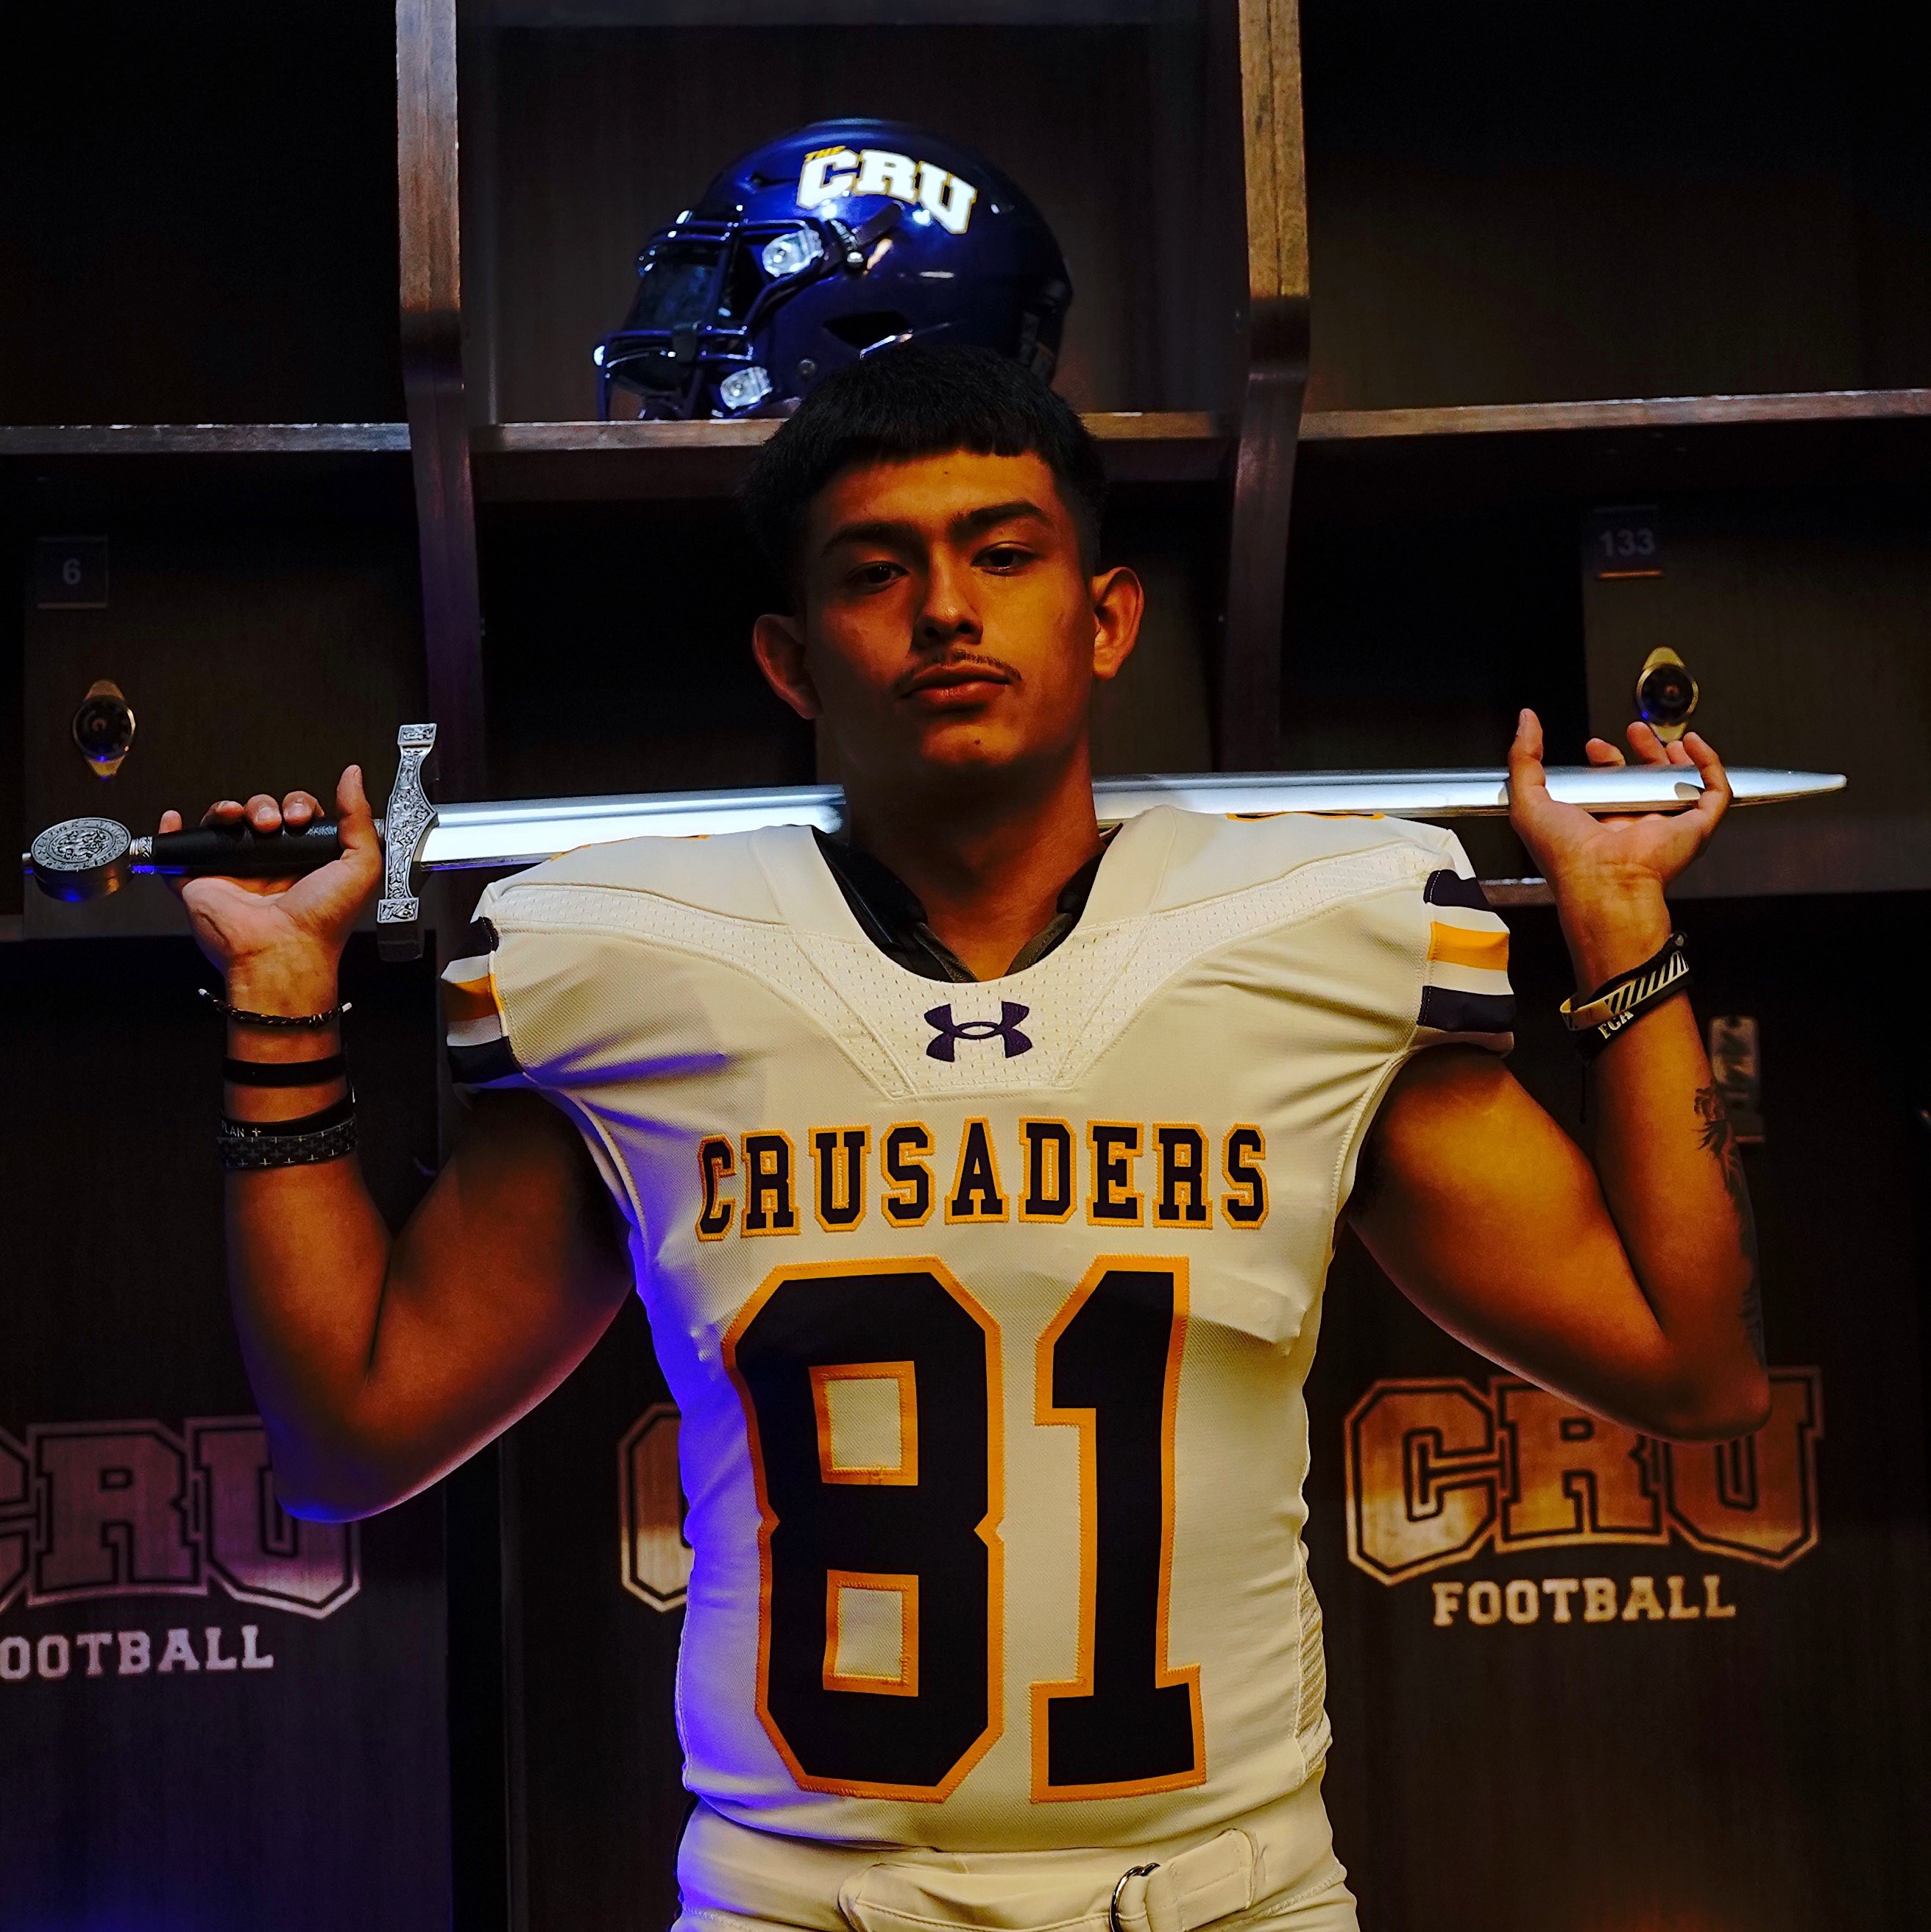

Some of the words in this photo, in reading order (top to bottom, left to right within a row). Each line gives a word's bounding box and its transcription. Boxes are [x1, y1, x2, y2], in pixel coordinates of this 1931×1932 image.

[796, 149, 978, 235] CRU
[62, 558, 82, 586] 6
[1599, 527, 1656, 557] 133
[695, 1117, 1269, 1242] CRUSADERS
[0, 1414, 363, 1620] RU
[722, 1254, 1208, 1804] 81
[1431, 1574, 1737, 1627] FOOTBALL
[0, 1623, 274, 1682] OOTBALL
